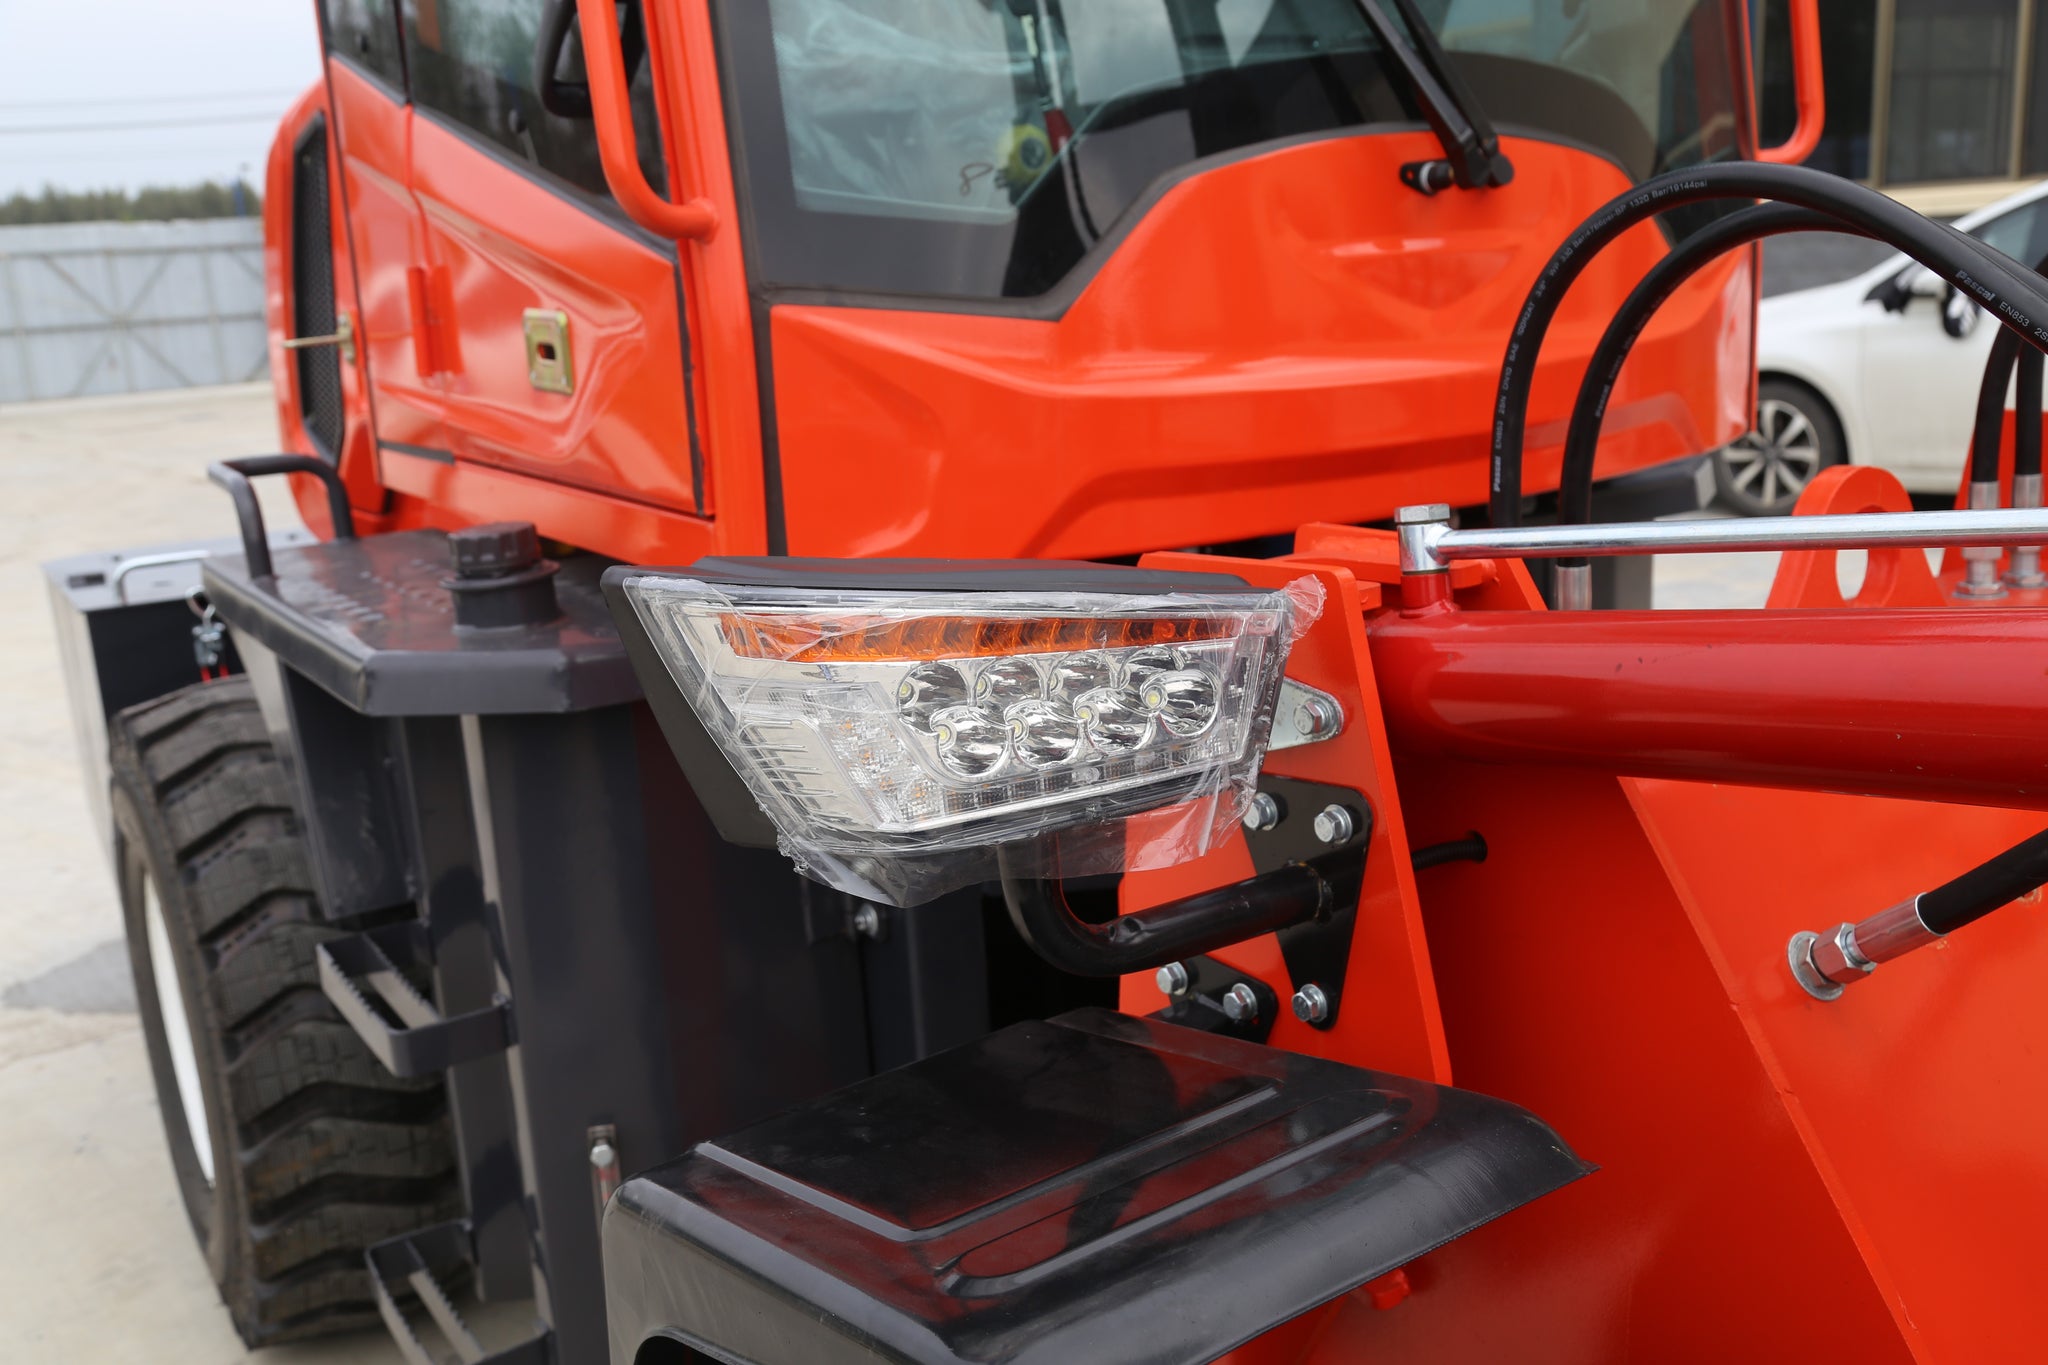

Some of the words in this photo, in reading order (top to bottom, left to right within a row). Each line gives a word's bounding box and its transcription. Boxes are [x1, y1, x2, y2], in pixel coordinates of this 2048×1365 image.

[1493, 455, 1502, 493] Pascal
[1508, 343, 1520, 362] SAE
[1629, 193, 1650, 208] 1320
[1955, 269, 1997, 302] Pascal
[1999, 301, 2030, 328] EN853
[2034, 327, 2048, 344] 2S
